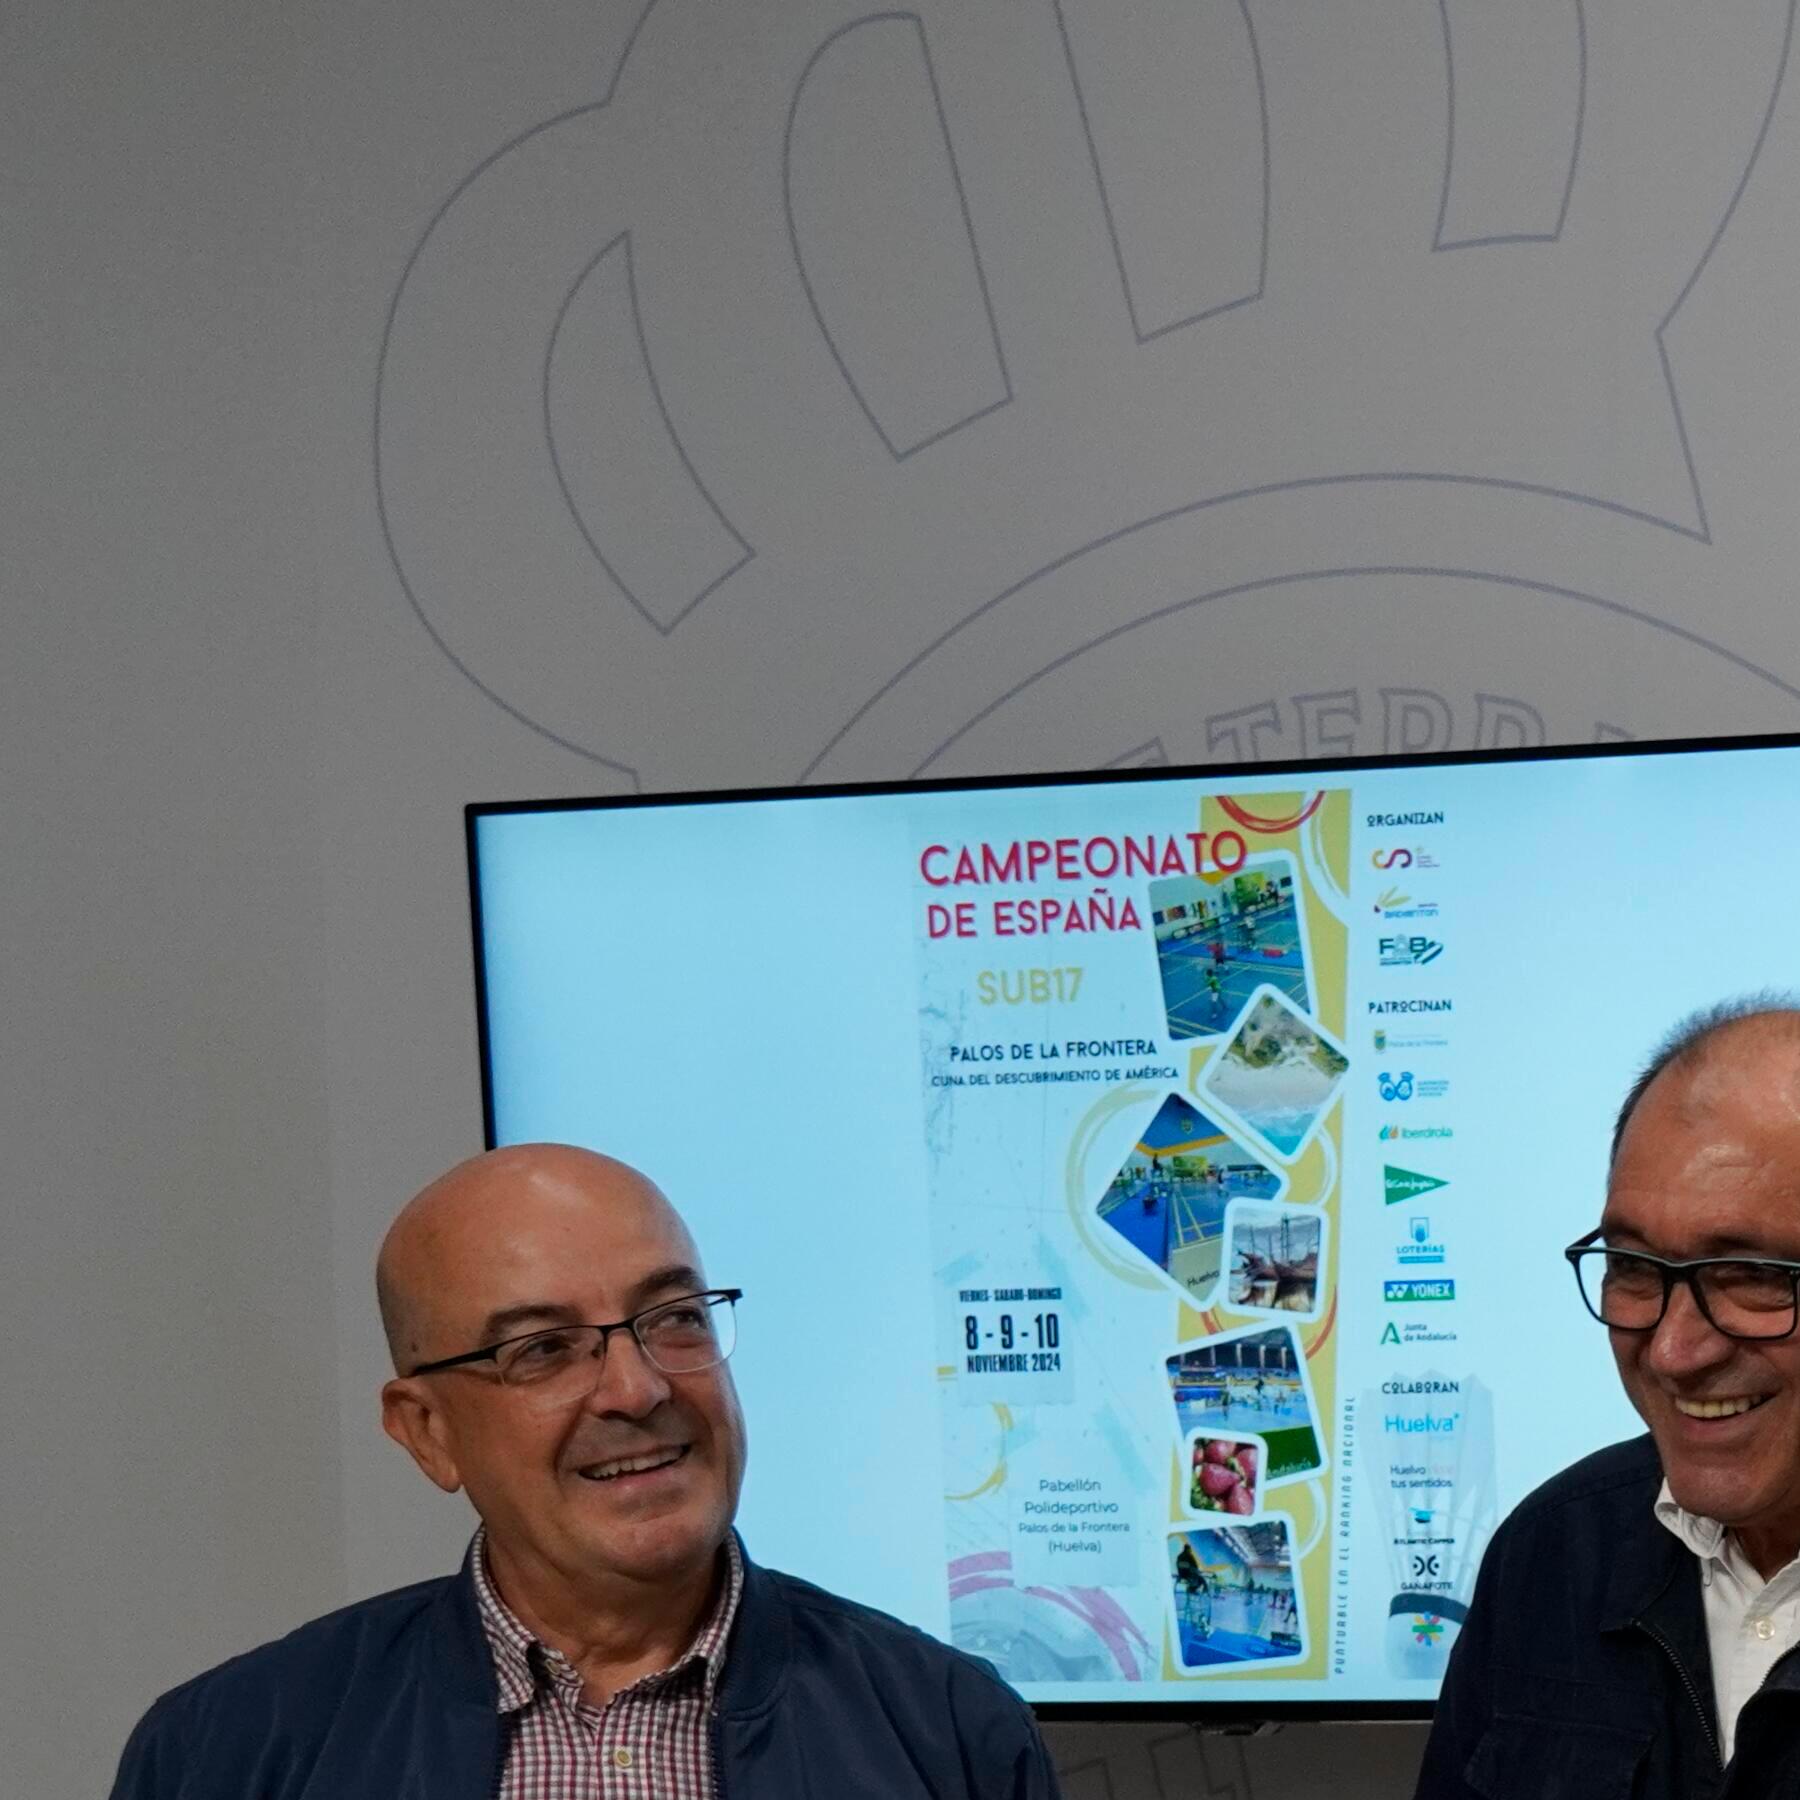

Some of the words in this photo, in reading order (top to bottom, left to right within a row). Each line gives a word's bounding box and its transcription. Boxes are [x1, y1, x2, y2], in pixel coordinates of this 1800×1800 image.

[1367, 811, 1444, 827] ORGANIZAN
[920, 830, 1247, 887] CAMPEONATO
[927, 904, 977, 938] DE
[994, 888, 1142, 934] ESPAÑA
[977, 967, 1083, 1005] SUB17
[1368, 999, 1452, 1014] PATROCINAN
[950, 1045, 1004, 1062] PALOS
[1011, 1043, 1034, 1060] DE
[1040, 1043, 1060, 1059] LA
[1066, 1039, 1157, 1058] FRONTERA
[931, 1075, 965, 1088] CUNA
[969, 1073, 991, 1086] DEL
[995, 1069, 1101, 1085] DESCUBRIMIENTO
[1105, 1068, 1121, 1081] DE
[1125, 1065, 1179, 1080] AMÉRICA
[1411, 1284, 1450, 1297] YONEX
[966, 1315, 979, 1350] 8
[1000, 1314, 1013, 1349] 9
[1035, 1313, 1059, 1349] 10
[967, 1354, 1028, 1373] NOVIEMBRE
[1032, 1353, 1061, 1372] 2024
[1382, 1381, 1459, 1395] COLABORAN
[1039, 1479, 1101, 1492] Pabellón
[1024, 1500, 1119, 1515] Polideportivo
[1019, 1522, 1049, 1533] Palos
[1051, 1522, 1066, 1533] de
[1068, 1522, 1078, 1532] la
[1081, 1522, 1130, 1532] Frontera
[1048, 1540, 1101, 1554] (Huelva)
